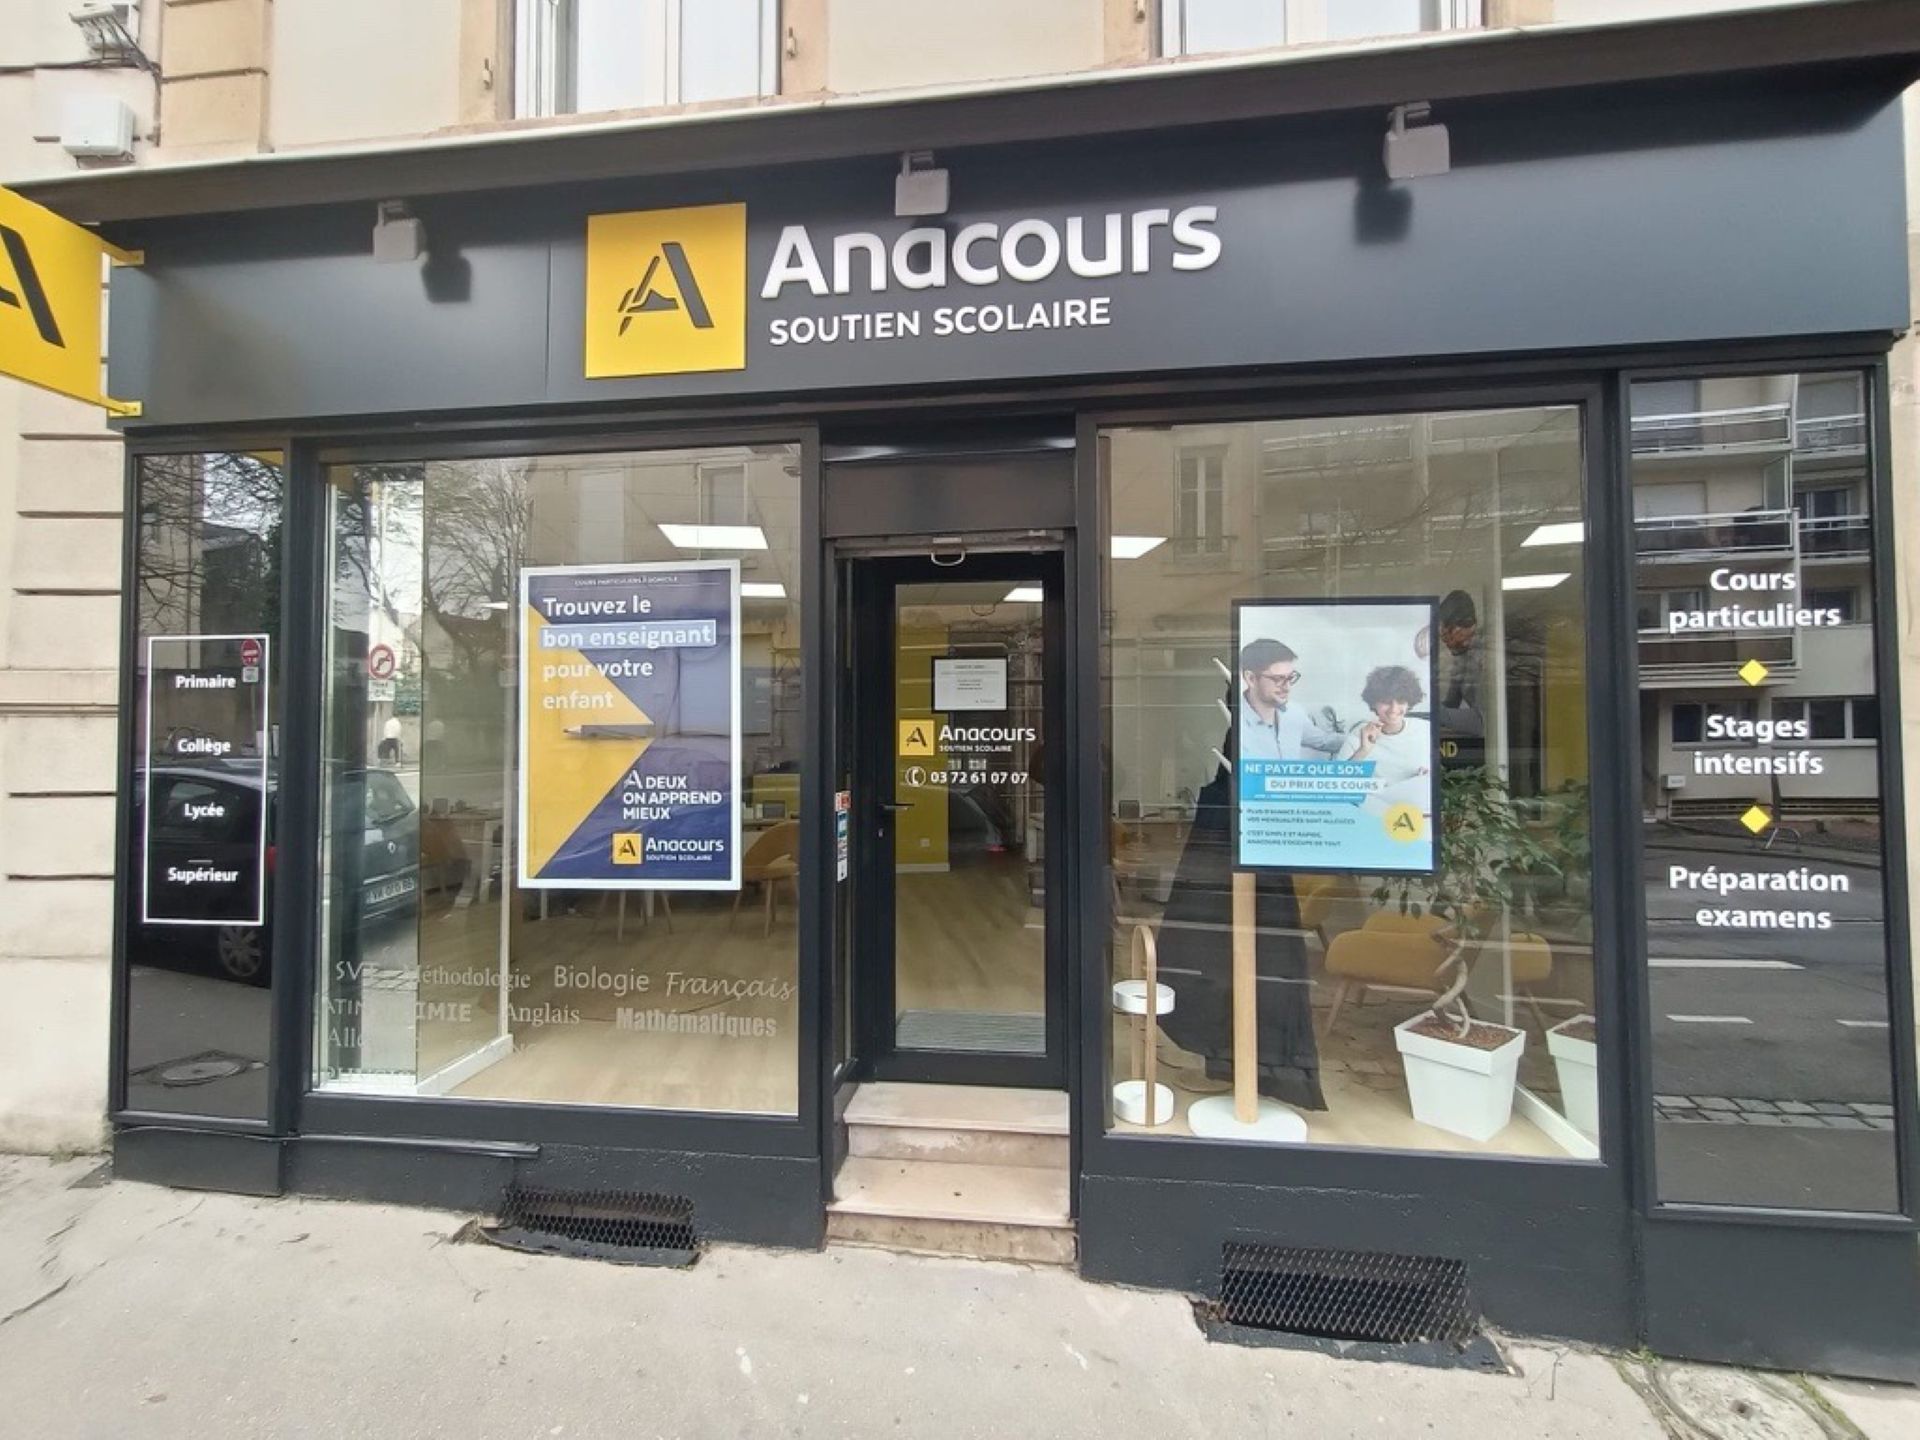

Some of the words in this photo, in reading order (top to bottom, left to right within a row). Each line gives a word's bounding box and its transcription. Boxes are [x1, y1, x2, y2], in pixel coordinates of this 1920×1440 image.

[760, 204, 1223, 299] Anacours
[768, 309, 921, 346] SOUTIEN
[932, 296, 1112, 335] SCOLAIRE
[1709, 568, 1797, 592] Cours
[542, 597, 627, 616] Trouvez
[632, 595, 652, 613] le
[1668, 604, 1842, 634] particuliers
[543, 628, 584, 647] bon
[589, 624, 713, 649] enseignant
[543, 663, 596, 682] pour
[598, 659, 653, 677] votre
[175, 675, 237, 689] Primaire
[543, 690, 614, 709] enfant
[938, 724, 1037, 741] Anacours
[1706, 714, 1809, 744] Stages
[177, 738, 231, 758] Collège
[1264, 763, 1305, 774] PAYEZ
[1307, 764, 1336, 775] QUE
[1337, 764, 1364, 775] 50%
[1693, 750, 1825, 775] intensifs
[645, 775, 687, 789] DEUX
[930, 771, 947, 784] 03
[950, 771, 968, 784] 72
[970, 771, 987, 784] 61
[990, 771, 1008, 784] 07
[1011, 771, 1029, 784] 07
[1270, 780, 1286, 789] DU
[1289, 780, 1314, 789] PRIX
[1316, 780, 1338, 789] DES
[1341, 781, 1378, 790] COURS
[623, 791, 648, 805] ON
[649, 791, 722, 805] APPREND
[184, 802, 225, 820] Lycée
[623, 807, 671, 820] MIEUX
[645, 837, 725, 851] Anacours
[167, 867, 239, 885] Supérieur
[1668, 864, 1849, 896] Préparation
[1695, 906, 1832, 930] examens
[553, 964, 650, 997] Biologie
[666, 970, 797, 1000] Français
[507, 1002, 581, 1028] Anglais
[615, 1007, 778, 1038] Mathématiques
